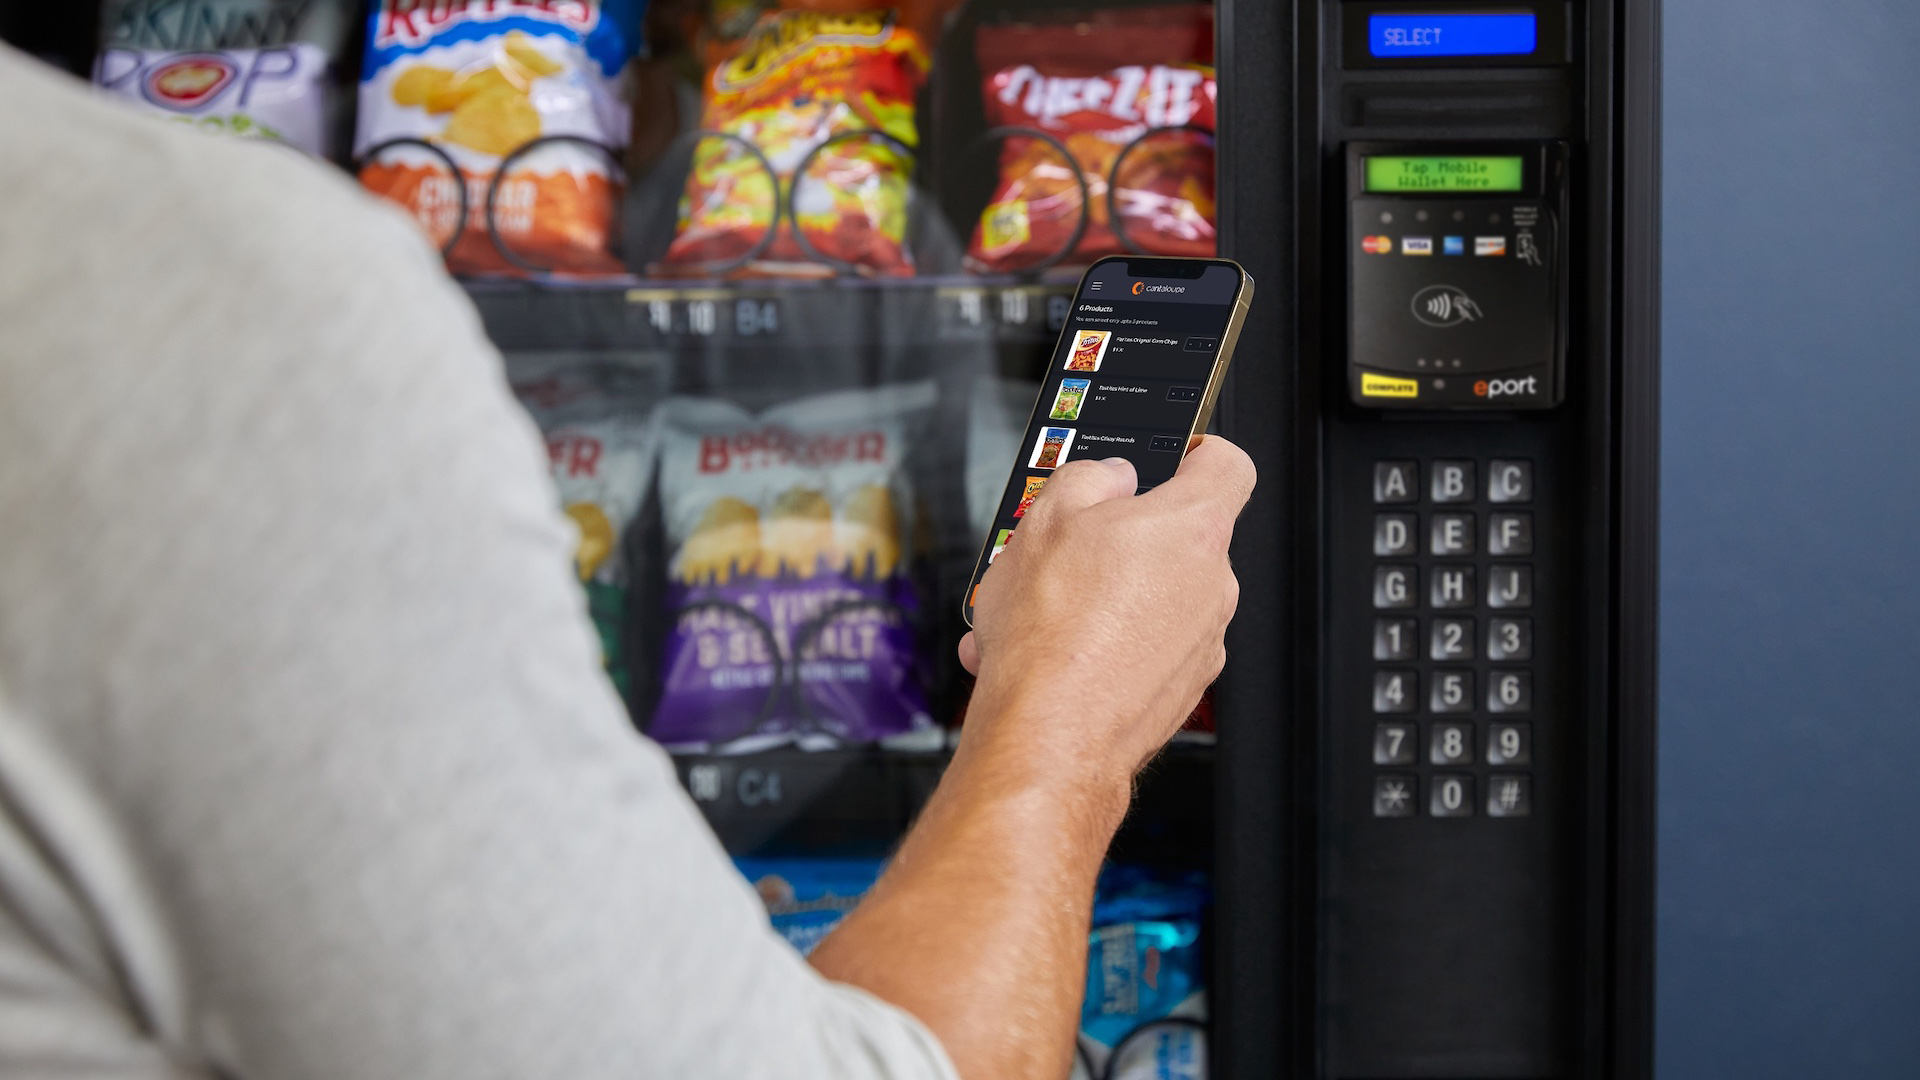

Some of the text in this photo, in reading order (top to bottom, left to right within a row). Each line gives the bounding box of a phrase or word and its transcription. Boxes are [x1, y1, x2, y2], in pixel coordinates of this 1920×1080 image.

[1384, 27, 1442, 46] SELECT
[1402, 161, 1488, 175] Tap Mobile
[1398, 175, 1489, 188] Wallet Here
[1406, 241, 1429, 250] VISA
[1145, 284, 1186, 295] cantaloupe
[1079, 304, 1114, 314] 6 Products
[1366, 382, 1414, 393] COMPLETE
[1473, 376, 1537, 398] eport
[1385, 465, 1522, 497] A B C
[1386, 519, 1520, 550] D E F
[1385, 571, 1519, 602] G H J
[1388, 623, 1520, 653] 1 2 3
[1385, 675, 1520, 705] 4 5 6
[1386, 728, 1520, 758] 7 8 9
[1442, 779, 1522, 811] 0 #
